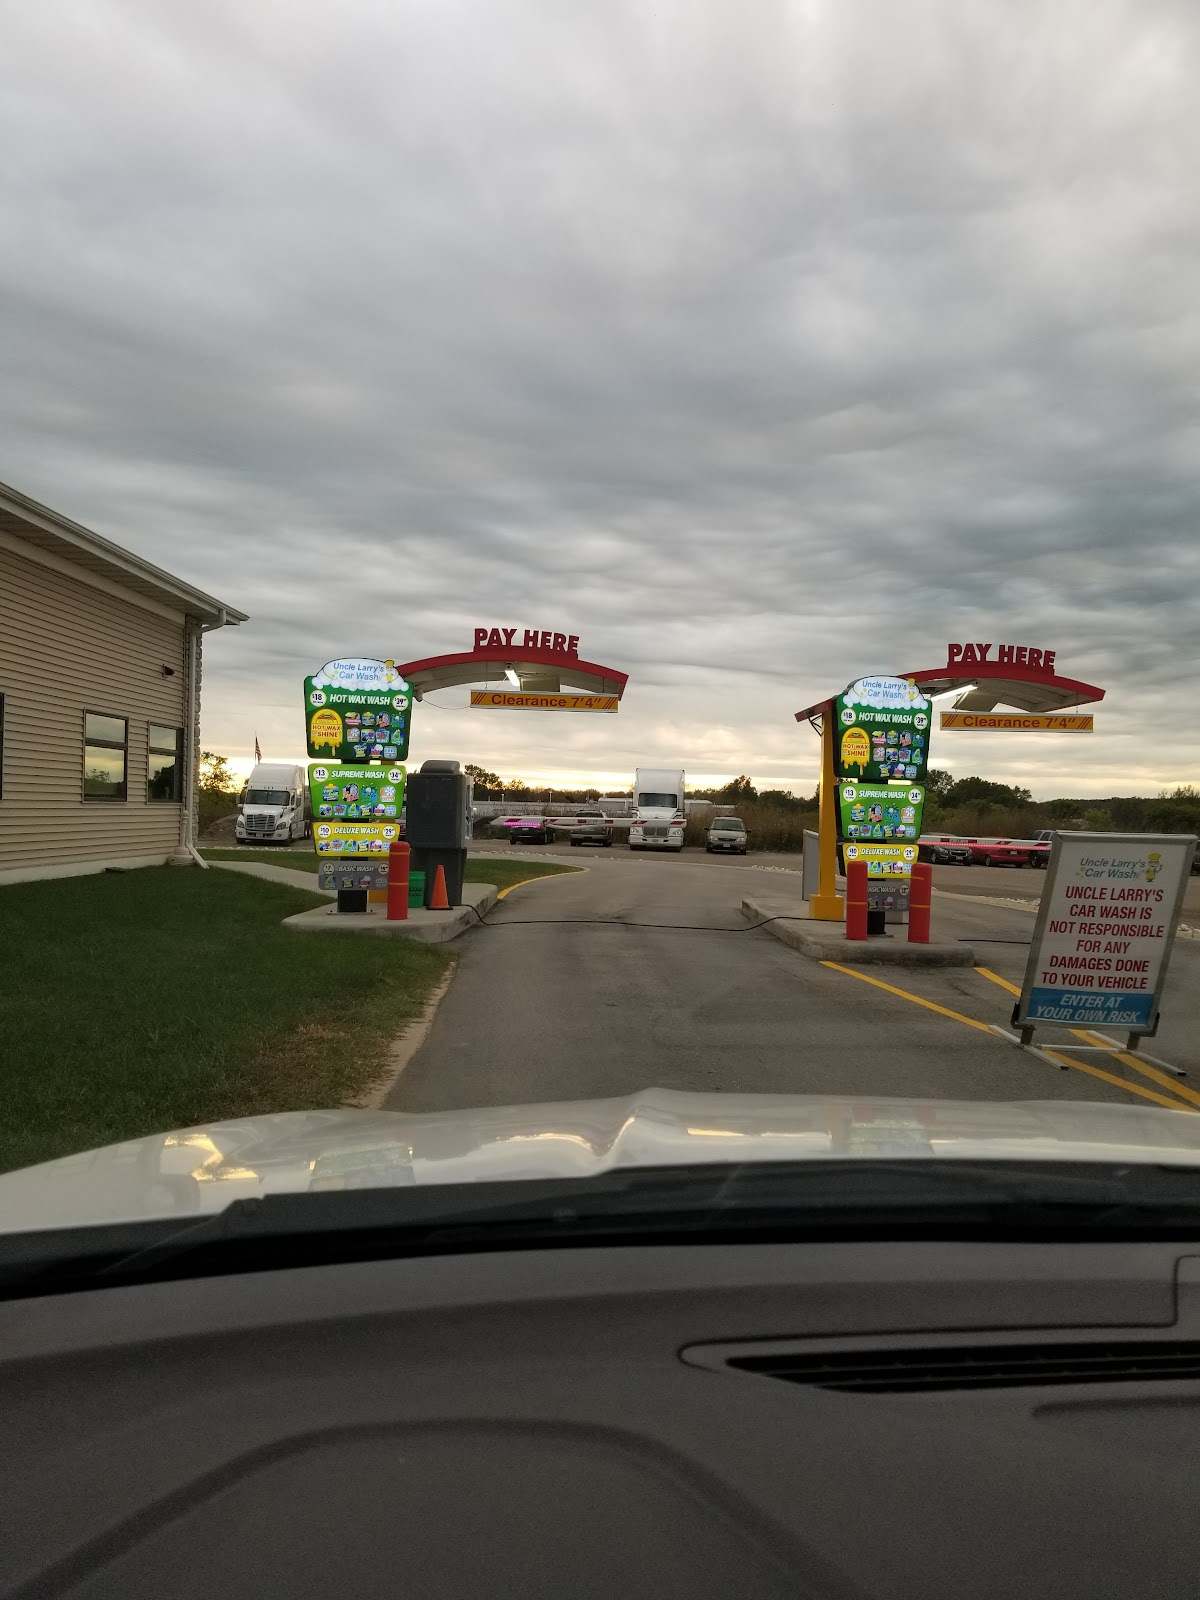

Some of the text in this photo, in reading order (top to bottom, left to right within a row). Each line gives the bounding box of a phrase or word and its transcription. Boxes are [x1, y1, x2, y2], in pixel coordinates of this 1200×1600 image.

[474, 628, 580, 651] PAY HERE
[948, 643, 1056, 667] PAY HERE
[333, 662, 384, 673] Uncle Larry's
[339, 671, 379, 680] Car Wash
[862, 680, 907, 690] Uncle Larry's
[329, 694, 348, 703] HOT
[348, 695, 367, 704] WAX
[367, 695, 391, 705] WASH
[867, 689, 903, 699] Car Wash
[491, 694, 567, 707] Clearance
[858, 712, 913, 724] HOT WAX WASH
[963, 716, 1040, 728] Clearance
[317, 730, 338, 738] SHINE
[331, 770, 385, 779] SUPREME WASH
[858, 790, 906, 799] SUPREME WASH
[360, 827, 379, 835] WASH
[1080, 857, 1146, 869] Uncle Larry's
[1084, 868, 1138, 879] Car Wash
[1065, 885, 1164, 902] UNCLE LARRY'S
[1070, 904, 1153, 919] CAR WASH IS
[1049, 921, 1165, 938] NOT RESPONSIBLE
[1076, 939, 1131, 955] FOR ANY
[1049, 955, 1150, 973] DAMAGES DONE
[1041, 971, 1149, 990] TO YOUR VEHICLE
[1059, 994, 1124, 1009] ENTER AT
[1035, 1005, 1141, 1023] YOUR OWN RISK
